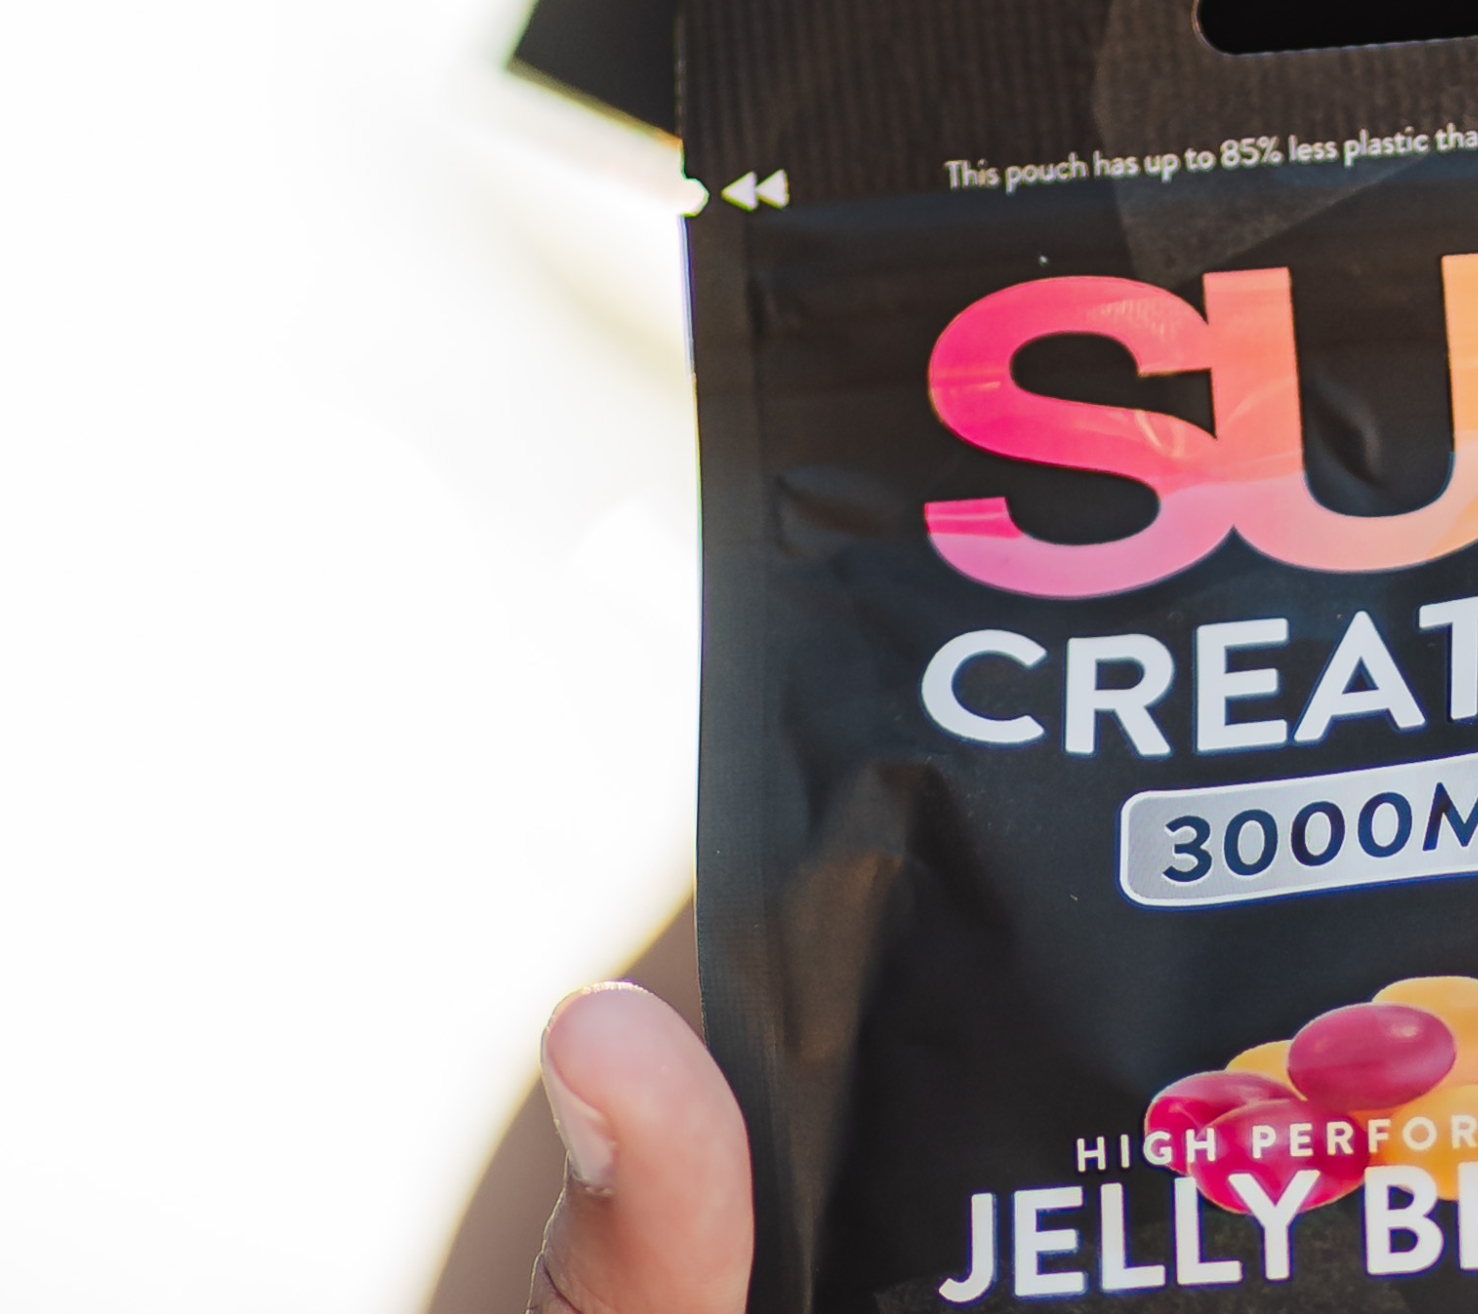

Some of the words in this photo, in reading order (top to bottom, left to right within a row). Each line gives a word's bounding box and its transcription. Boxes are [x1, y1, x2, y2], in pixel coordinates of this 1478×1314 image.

[944, 159, 1000, 188] This
[1006, 152, 1089, 195] pouch
[1093, 150, 1140, 177] has
[1144, 153, 1180, 183] up
[1185, 148, 1216, 171] to
[1221, 135, 1284, 168] 85%
[1289, 134, 1338, 162] less
[1344, 126, 1429, 167] plastic
[1076, 1126, 1218, 1173] HIGH
[937, 1168, 1321, 1304] JELLY
